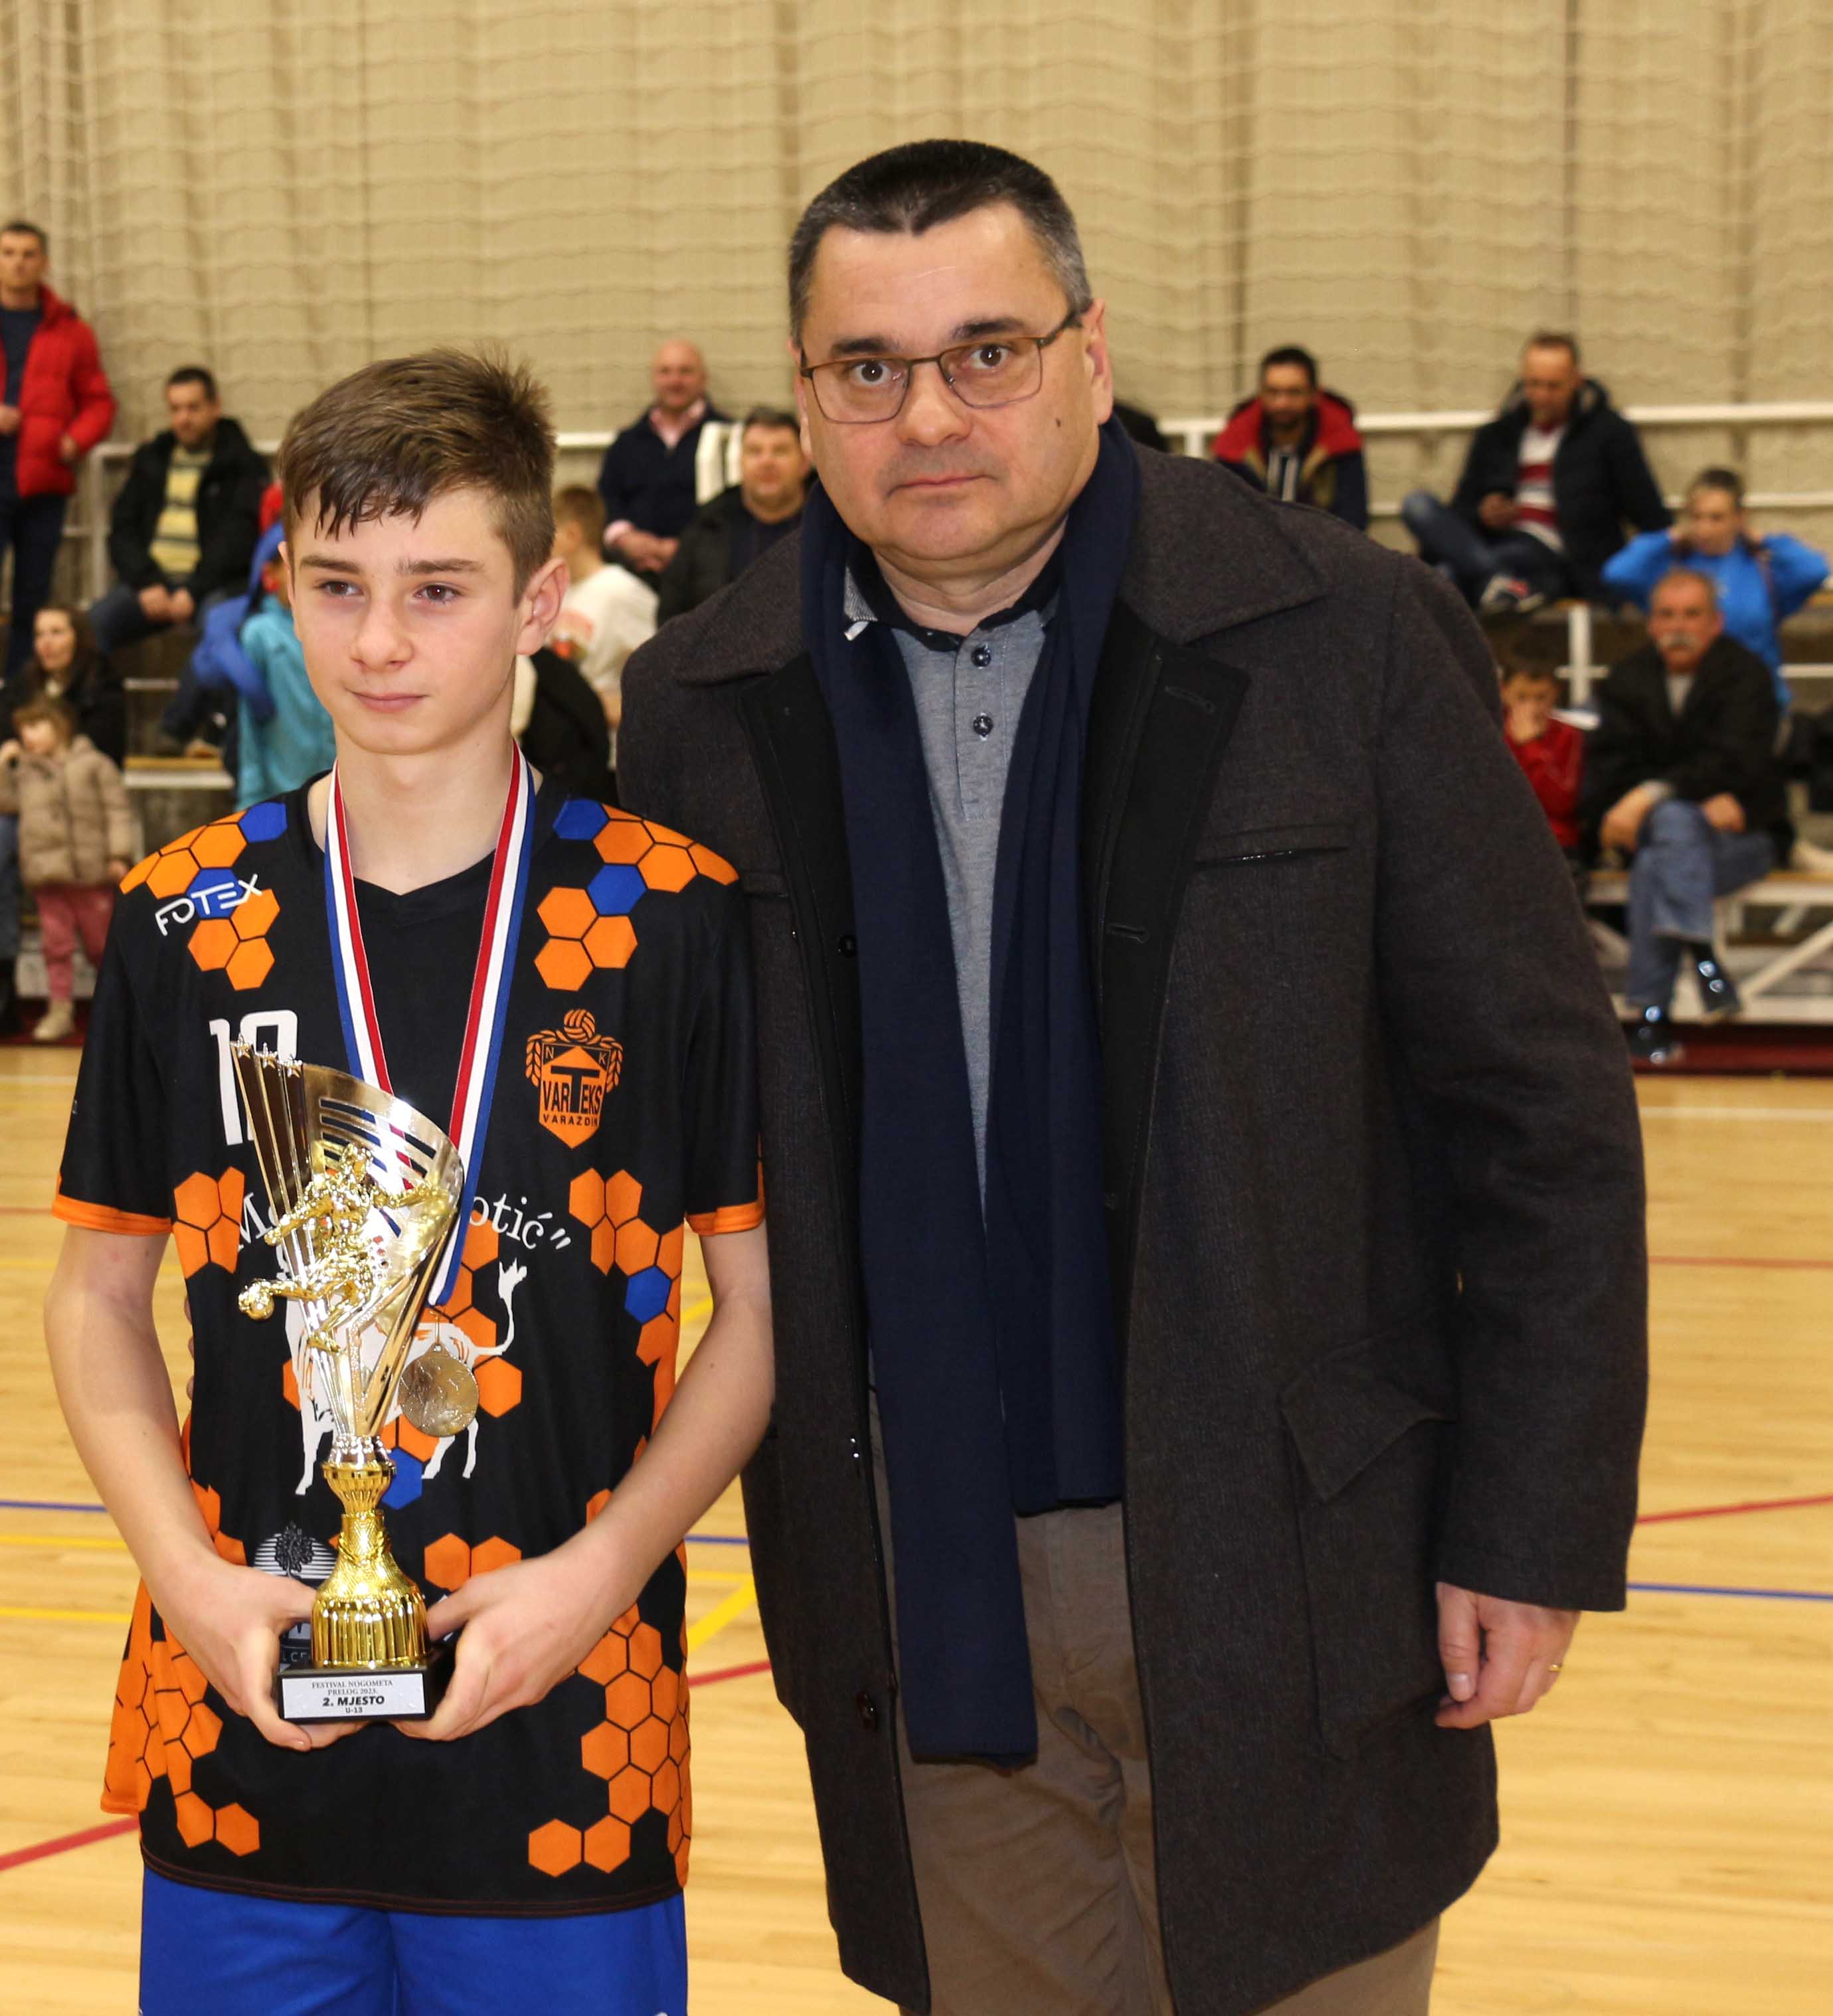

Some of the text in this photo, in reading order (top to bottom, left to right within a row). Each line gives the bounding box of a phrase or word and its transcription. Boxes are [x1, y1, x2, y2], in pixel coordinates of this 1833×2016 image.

[155, 873, 262, 936] FOTEX
[542, 1065, 603, 1115] VARTEKS
[543, 1114, 598, 1127] VARAŽDIN
[348, 1679, 393, 1688] NOGOMETA
[322, 1696, 385, 1707] 2. MJESTO
